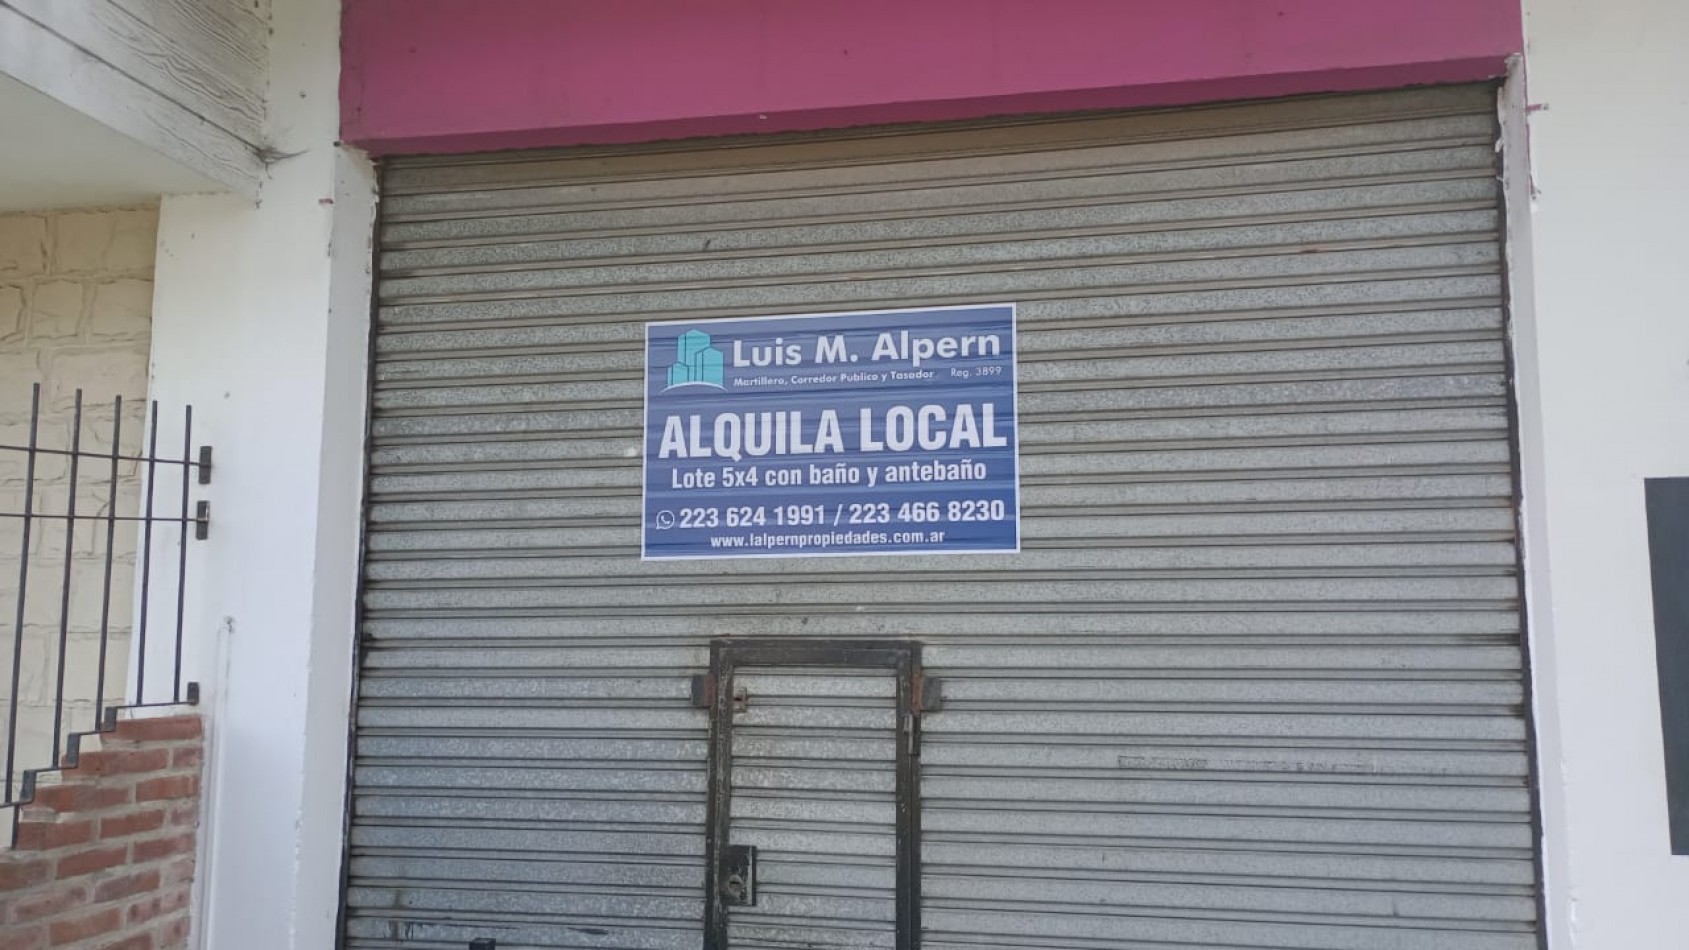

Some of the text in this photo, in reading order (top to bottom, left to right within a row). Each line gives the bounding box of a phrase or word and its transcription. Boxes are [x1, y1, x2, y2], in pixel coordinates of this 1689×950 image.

[733, 329, 1000, 368] Luis M. Alpern
[733, 376, 788, 387] Martillero,
[791, 374, 836, 385] Corredor
[881, 373, 887, 382] y
[890, 370, 934, 380] Tasador
[951, 366, 1003, 379] Reg. 3899
[658, 402, 1008, 462] ALQUILA LOCAL
[672, 458, 987, 489] Lote 5x4 con baño y antebaño
[679, 499, 1005, 529] 223 624 1991 / 223 466 8230
[710, 530, 946, 549] www.lalpernpropiedades.com.ar
